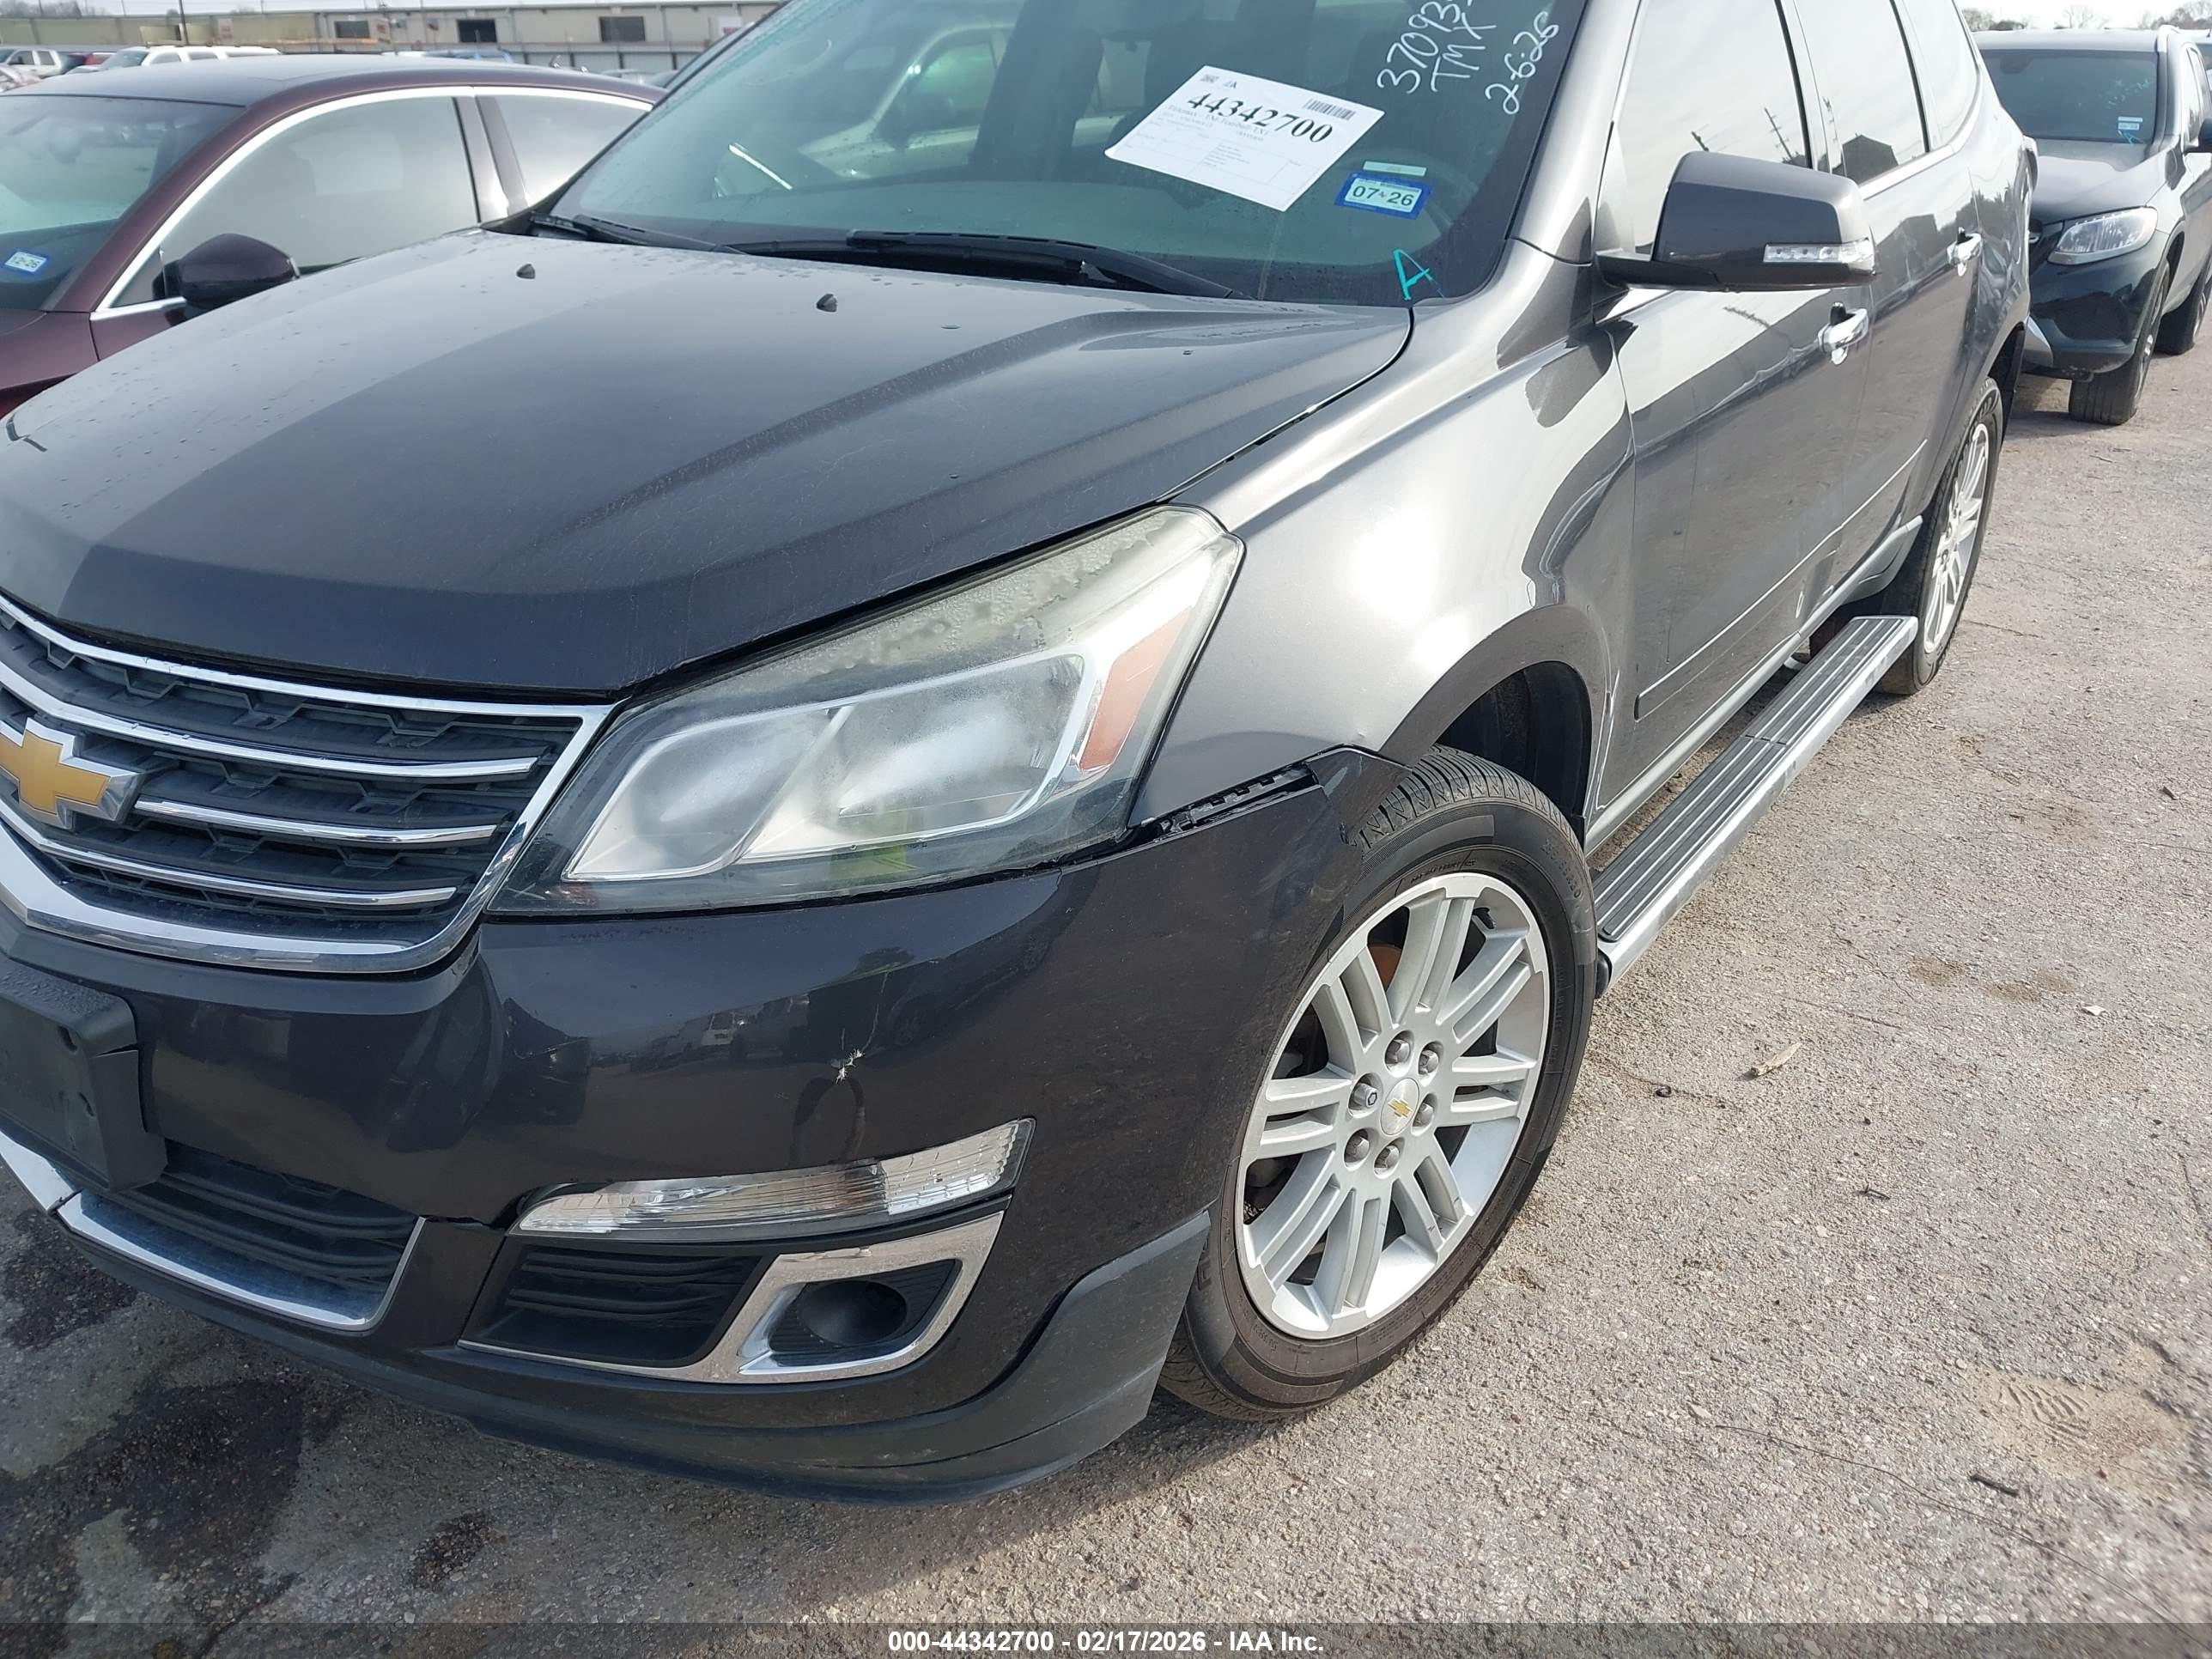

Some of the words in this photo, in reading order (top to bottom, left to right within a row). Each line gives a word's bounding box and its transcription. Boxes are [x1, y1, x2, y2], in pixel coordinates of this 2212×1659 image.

[1376, 0, 1473, 94] 37093
[1430, 12, 1497, 92] TMX
[1188, 93, 1333, 143] 44342700
[1352, 185, 1380, 198] 07
[1387, 191, 1415, 206] 26
[1393, 249, 1439, 301] A
